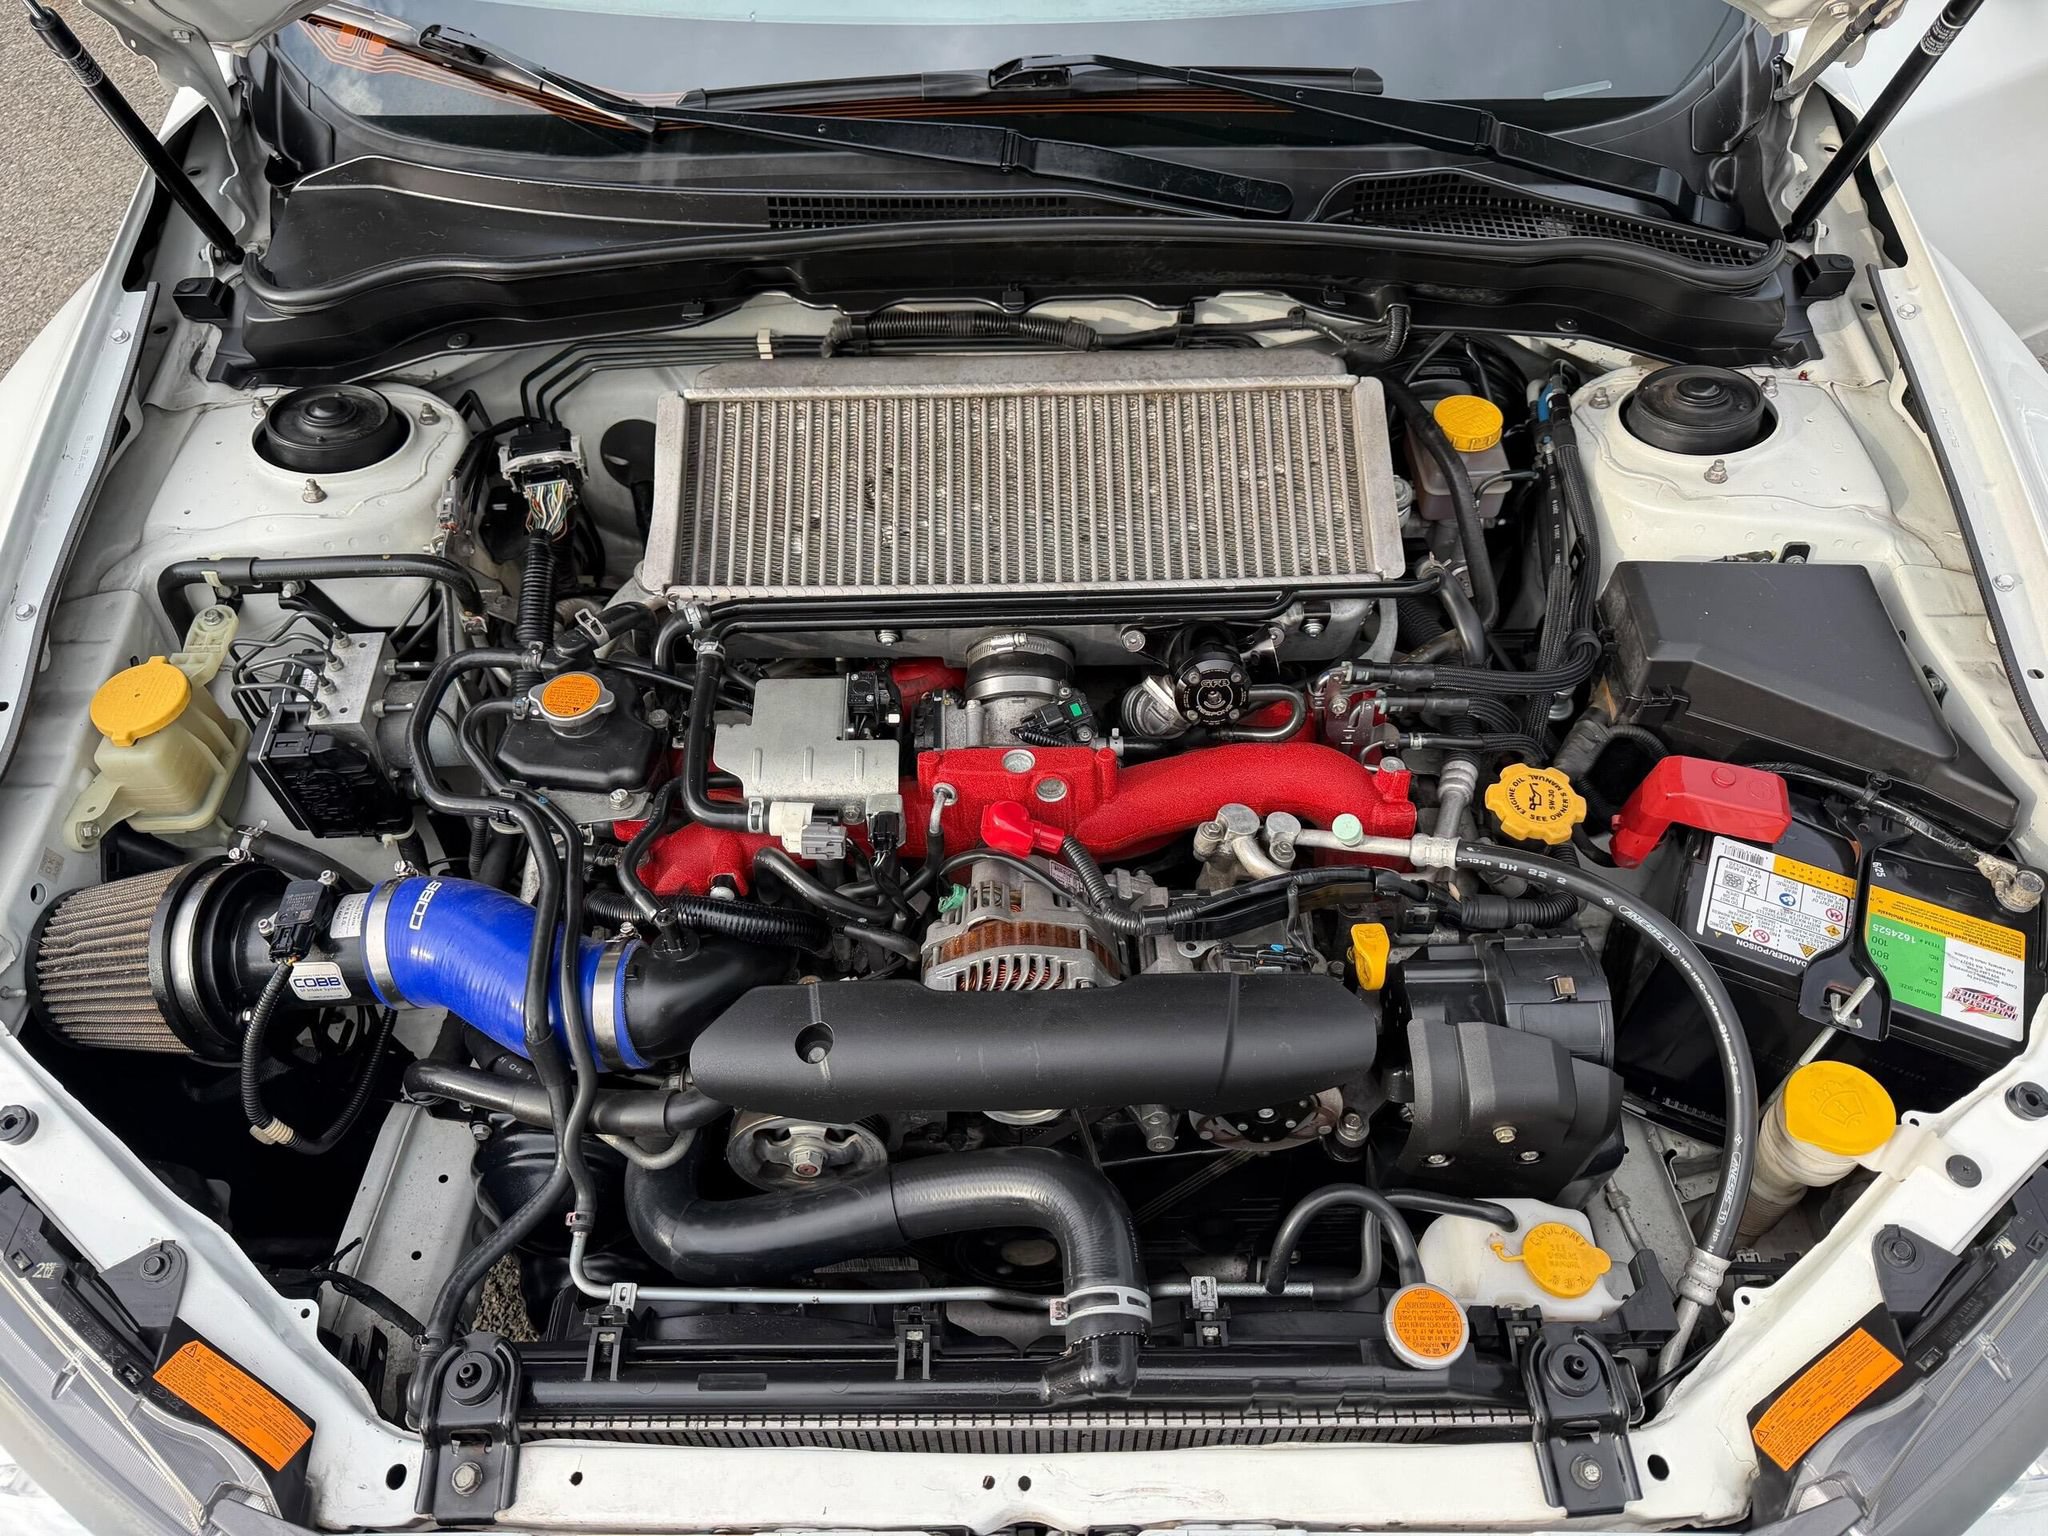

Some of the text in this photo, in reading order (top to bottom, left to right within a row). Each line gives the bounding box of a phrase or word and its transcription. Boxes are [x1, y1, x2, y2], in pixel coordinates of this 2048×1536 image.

[1528, 774, 1562, 790] MANUAL
[1508, 777, 1526, 815] ENGINE OIL
[1499, 862, 1518, 872] BH
[1528, 868, 1548, 878] 22
[409, 880, 442, 930] COBB
[1871, 935, 1888, 948] 100
[1872, 922, 1918, 945] 1624525
[1736, 939, 1808, 968] DANGER/POISON
[1870, 947, 1889, 960] 800
[1680, 957, 1691, 970] HP
[294, 977, 341, 988] COBB
[1914, 987, 1937, 999] GROUP
[1953, 987, 2015, 1012] BATTERIES
[1948, 992, 2016, 1020] INTERSTATE
[1712, 1228, 1720, 1242] HP
